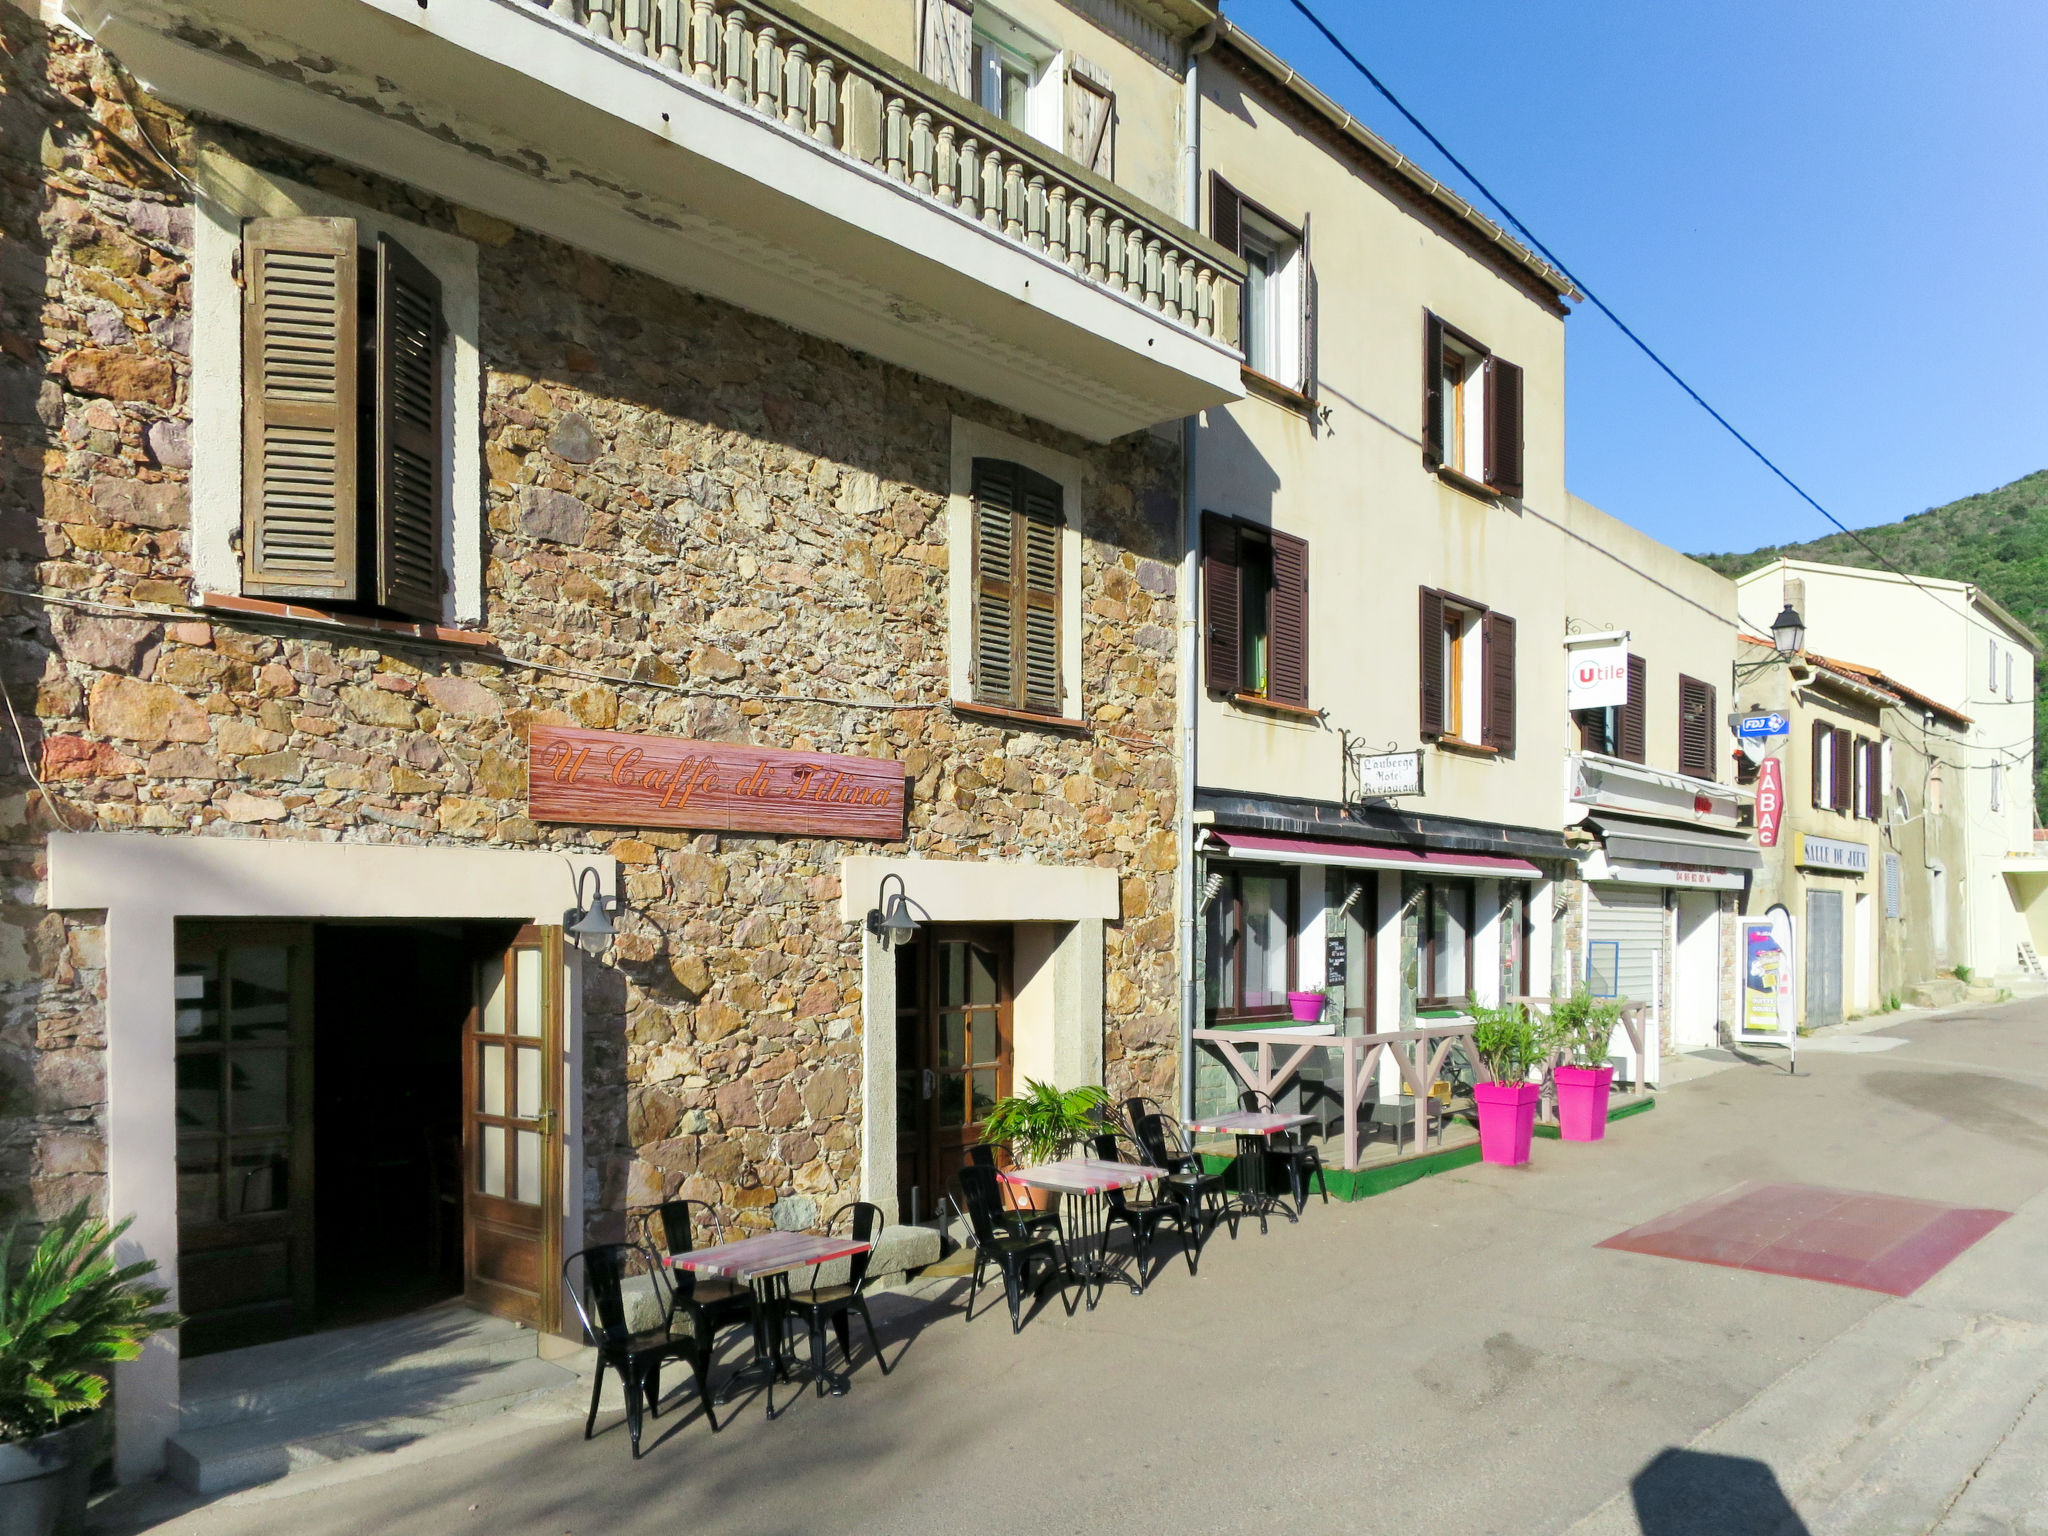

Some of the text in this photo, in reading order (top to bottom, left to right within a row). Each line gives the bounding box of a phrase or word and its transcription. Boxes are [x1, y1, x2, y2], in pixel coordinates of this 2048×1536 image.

[1580, 665, 1625, 682] Utile
[1745, 719, 1766, 729] FDJ
[606, 745, 720, 809] Caffè
[736, 760, 774, 797] di
[1760, 761, 1775, 843] TABAC
[1804, 844, 1867, 867] SALLE DE JEUX
